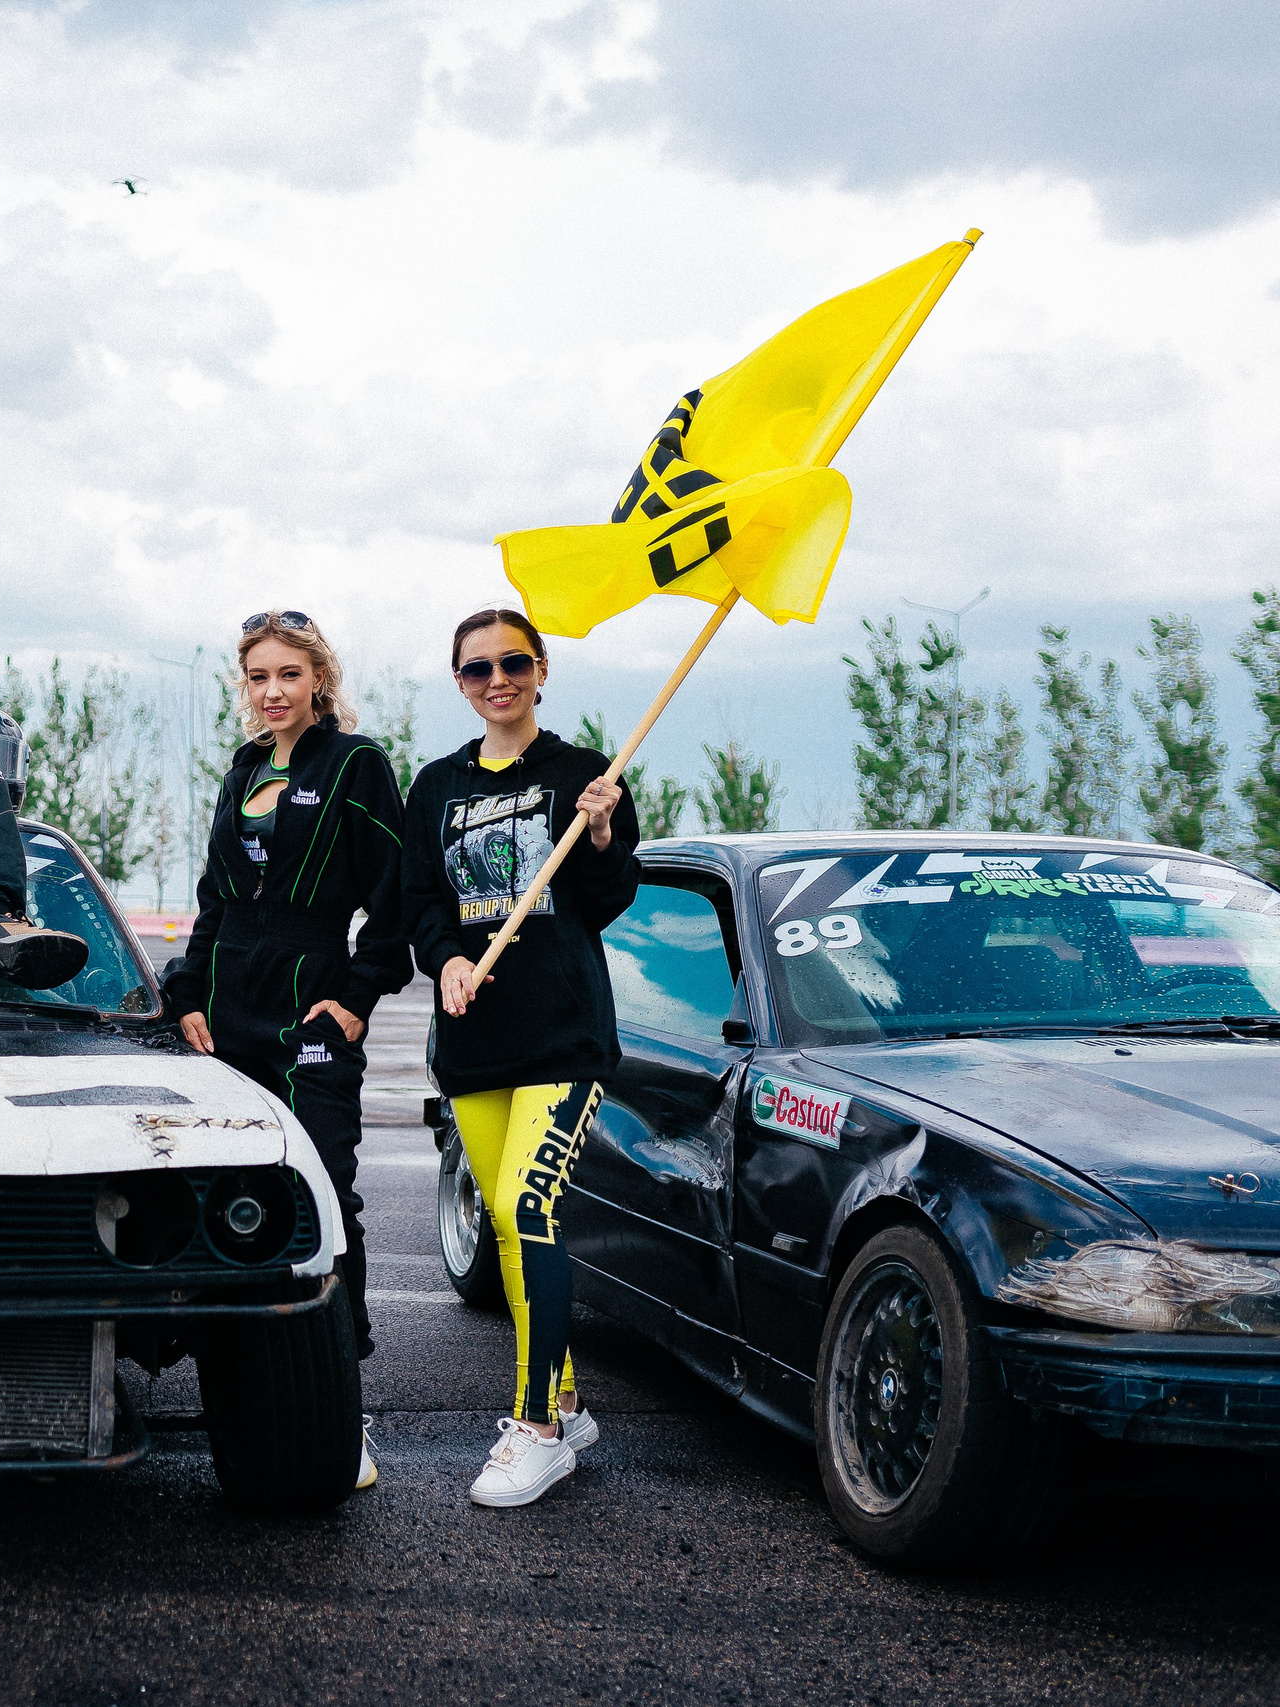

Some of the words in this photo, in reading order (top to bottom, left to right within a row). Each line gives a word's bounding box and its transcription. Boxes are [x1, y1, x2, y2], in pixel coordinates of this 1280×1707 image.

[290, 794, 321, 805] GORILLA
[981, 869, 1043, 880] GORILLA
[1061, 872, 1152, 886] STREET
[1087, 882, 1167, 897] LEGAL
[483, 898, 500, 916] UP
[774, 914, 863, 957] 89
[297, 1052, 333, 1065] GORILLA
[776, 1086, 841, 1138] Castrol
[516, 1129, 573, 1239] PARI
